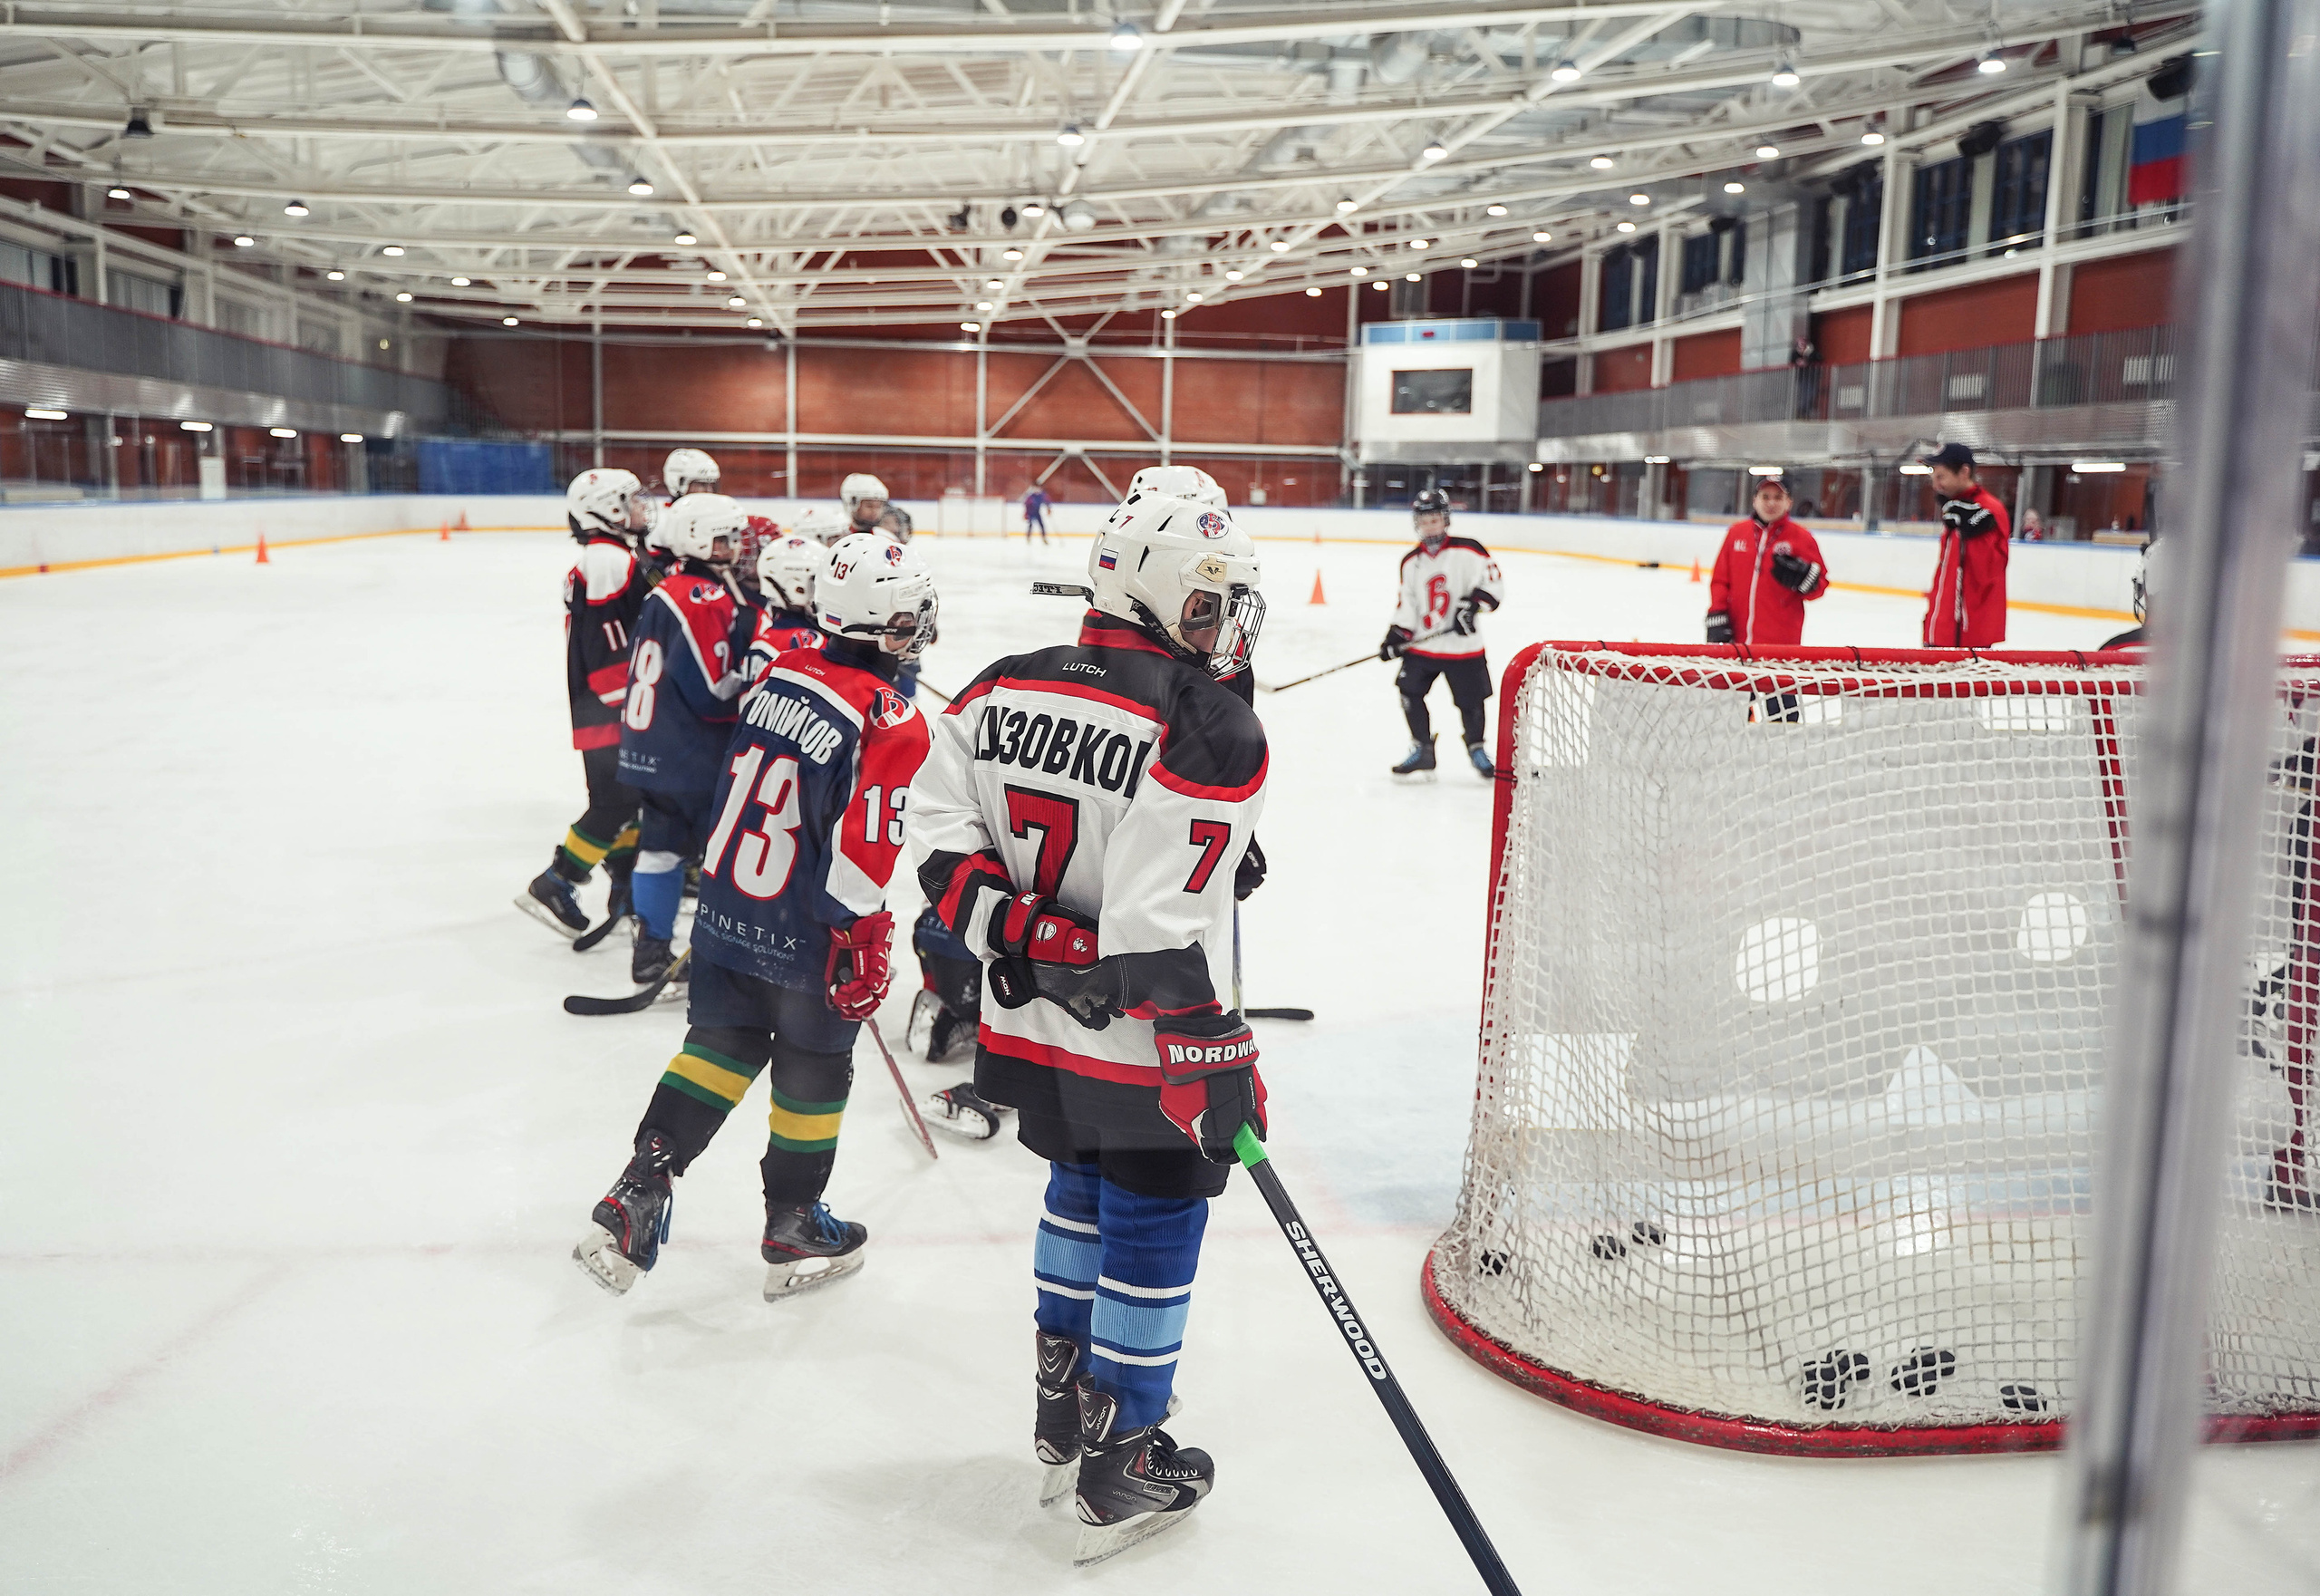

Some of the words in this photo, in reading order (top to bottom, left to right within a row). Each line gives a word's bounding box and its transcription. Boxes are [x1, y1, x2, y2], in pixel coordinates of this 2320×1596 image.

[1118, 515, 1134, 530] 7
[834, 561, 849, 581] 13
[602, 619, 629, 653] 11
[804, 663, 826, 677] LUTCH
[1061, 662, 1107, 678] LUTCH
[974, 705, 1153, 800] УЗОВКО
[701, 742, 803, 901] 13
[863, 783, 910, 847] 13
[1003, 782, 1080, 903] 7
[1183, 817, 1232, 895] 7
[752, 943, 796, 962] SOLUTIONS
[1285, 1221, 1387, 1380] SHER-WOOD
